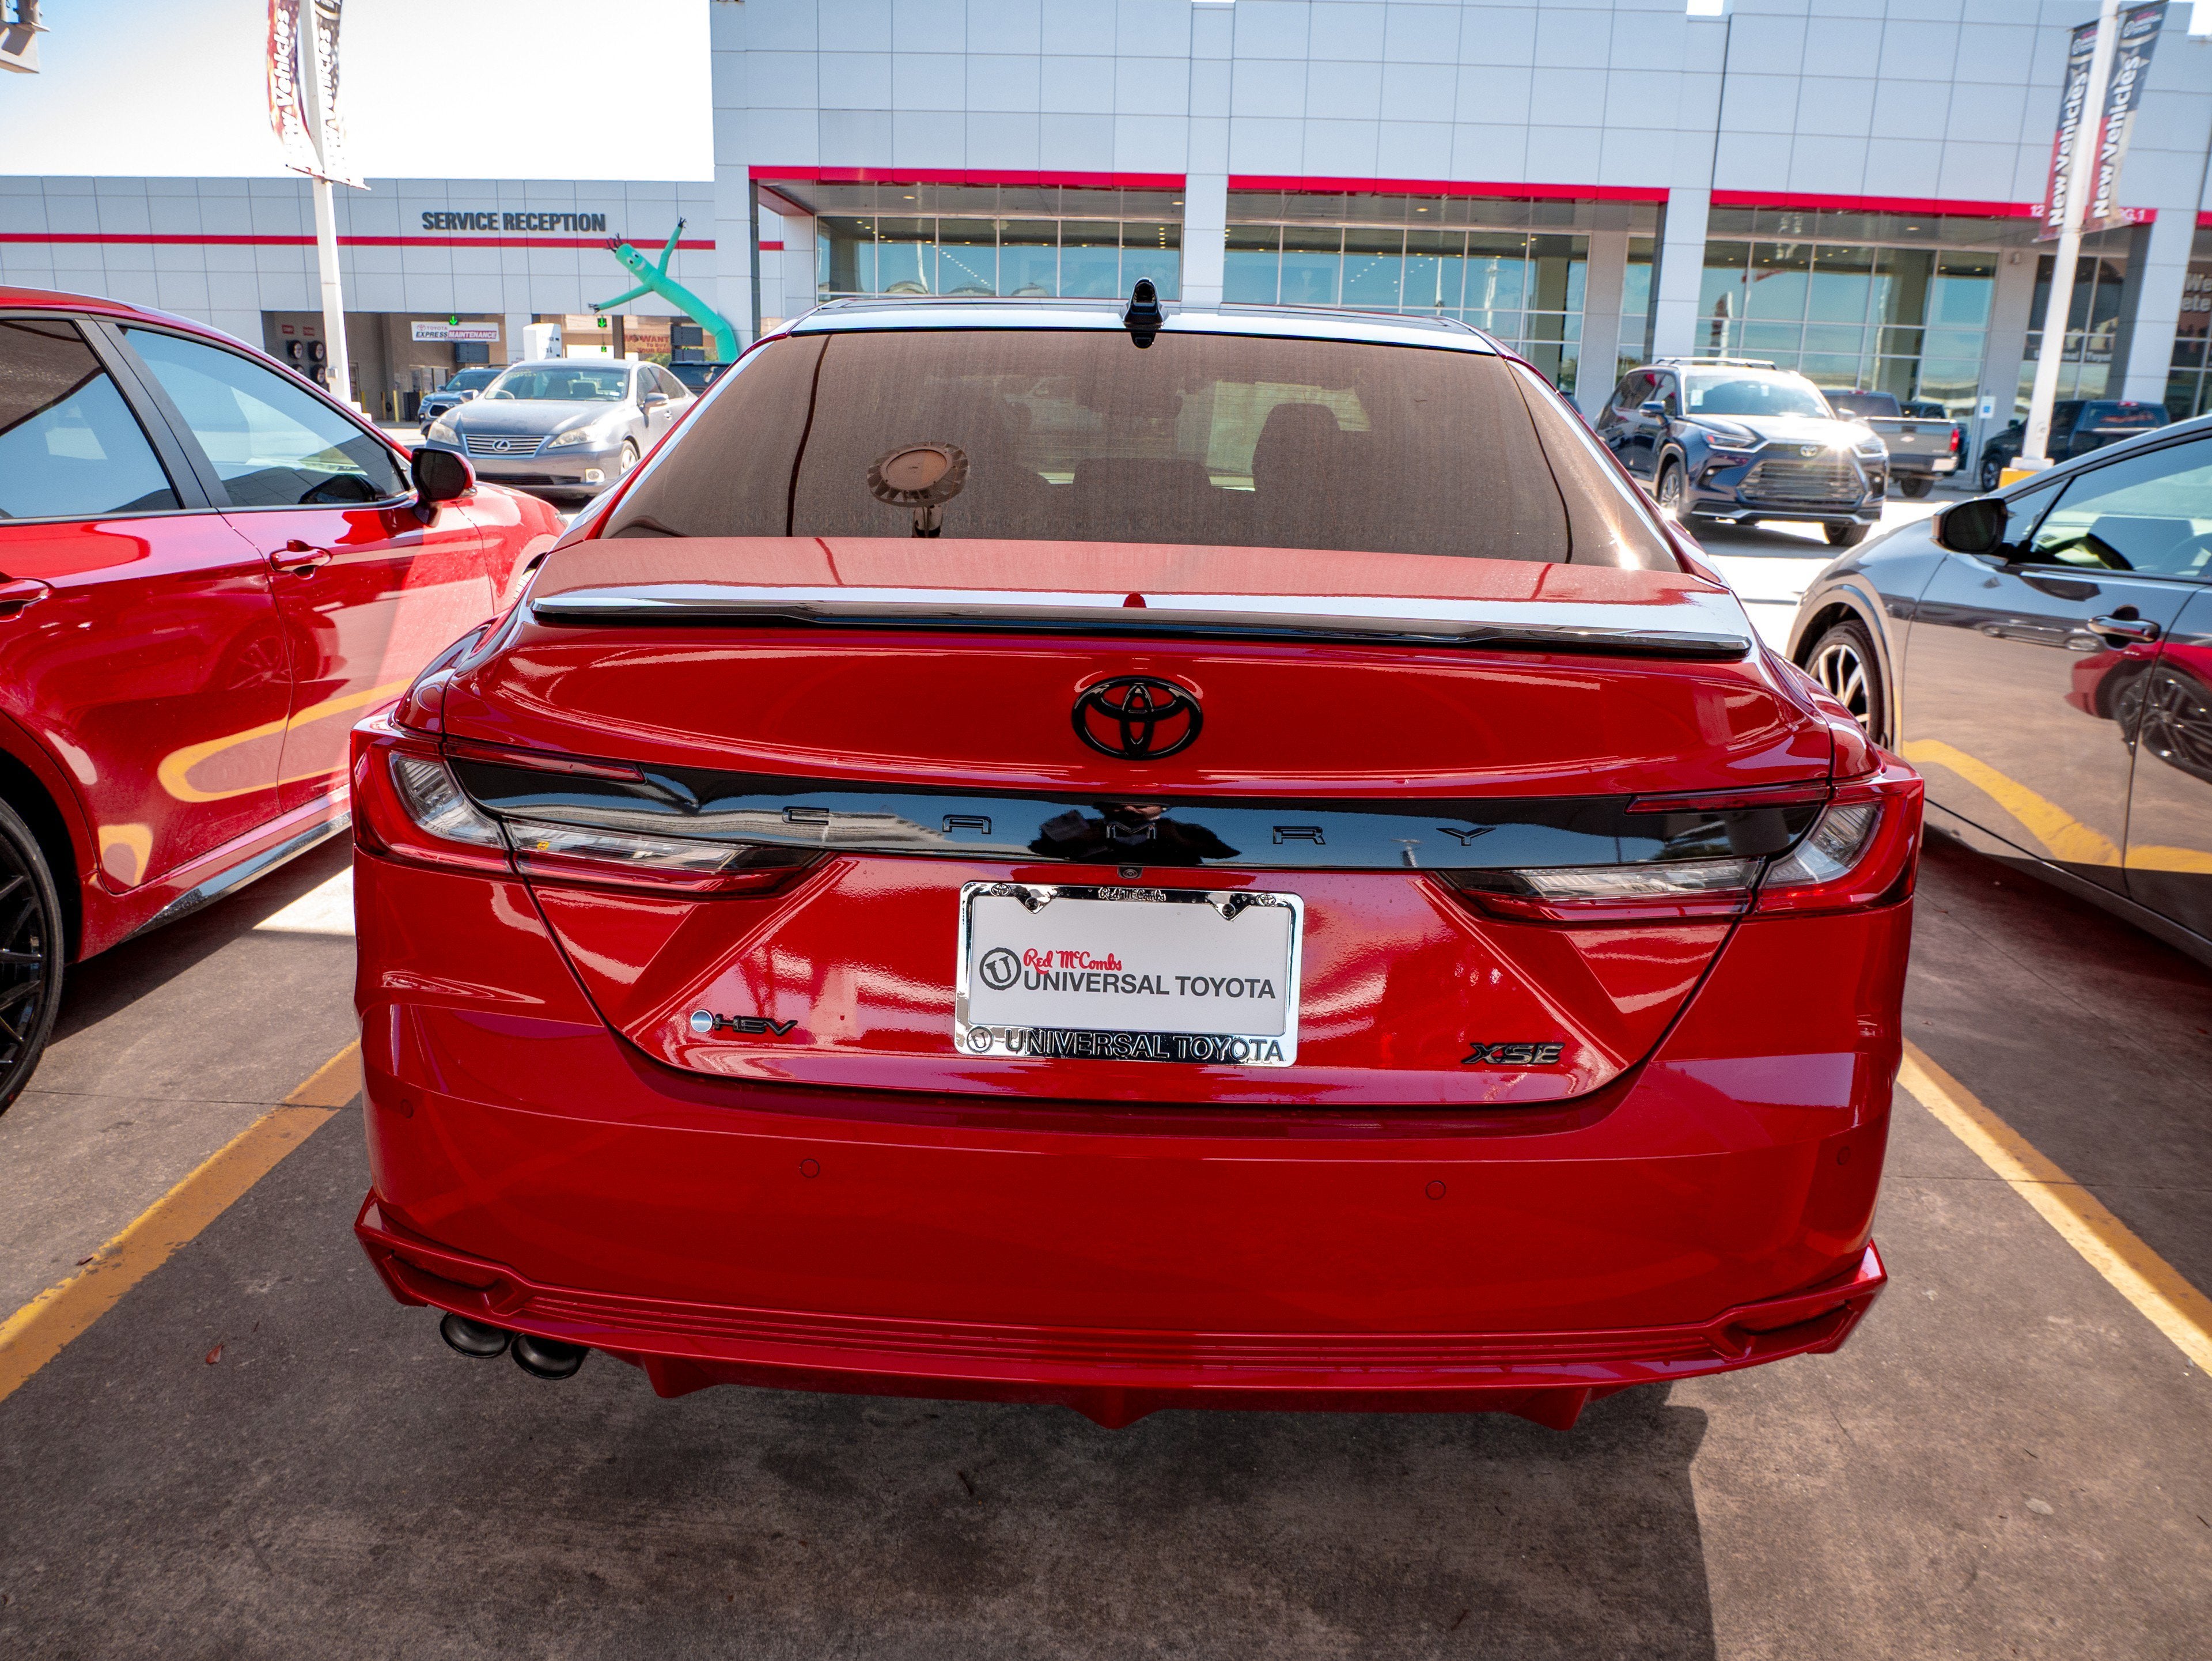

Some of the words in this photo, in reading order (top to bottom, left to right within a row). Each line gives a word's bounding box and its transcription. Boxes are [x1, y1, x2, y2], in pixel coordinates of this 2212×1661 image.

[273, 8, 294, 107] Vehicles
[2054, 71, 2088, 172] Vehicles
[2100, 55, 2141, 161] Vehicles
[2048, 176, 2067, 227] New
[2093, 165, 2113, 218] New
[422, 211, 498, 230] SERVICE
[502, 213, 606, 232] RECEPTION
[782, 805, 1497, 846] CAMRY
[1098, 887, 1120, 901] Red
[1023, 948, 1054, 975] Red
[1055, 949, 1122, 971] McCombs
[1024, 970, 1170, 996] UNIVERSAL
[1175, 975, 1277, 999] TOYOTA
[713, 1013, 798, 1036] HEV
[1004, 1028, 1171, 1059] UNIVERSAL
[1172, 1035, 1287, 1062] TOYOTA
[1461, 1043, 1565, 1064] XSE
